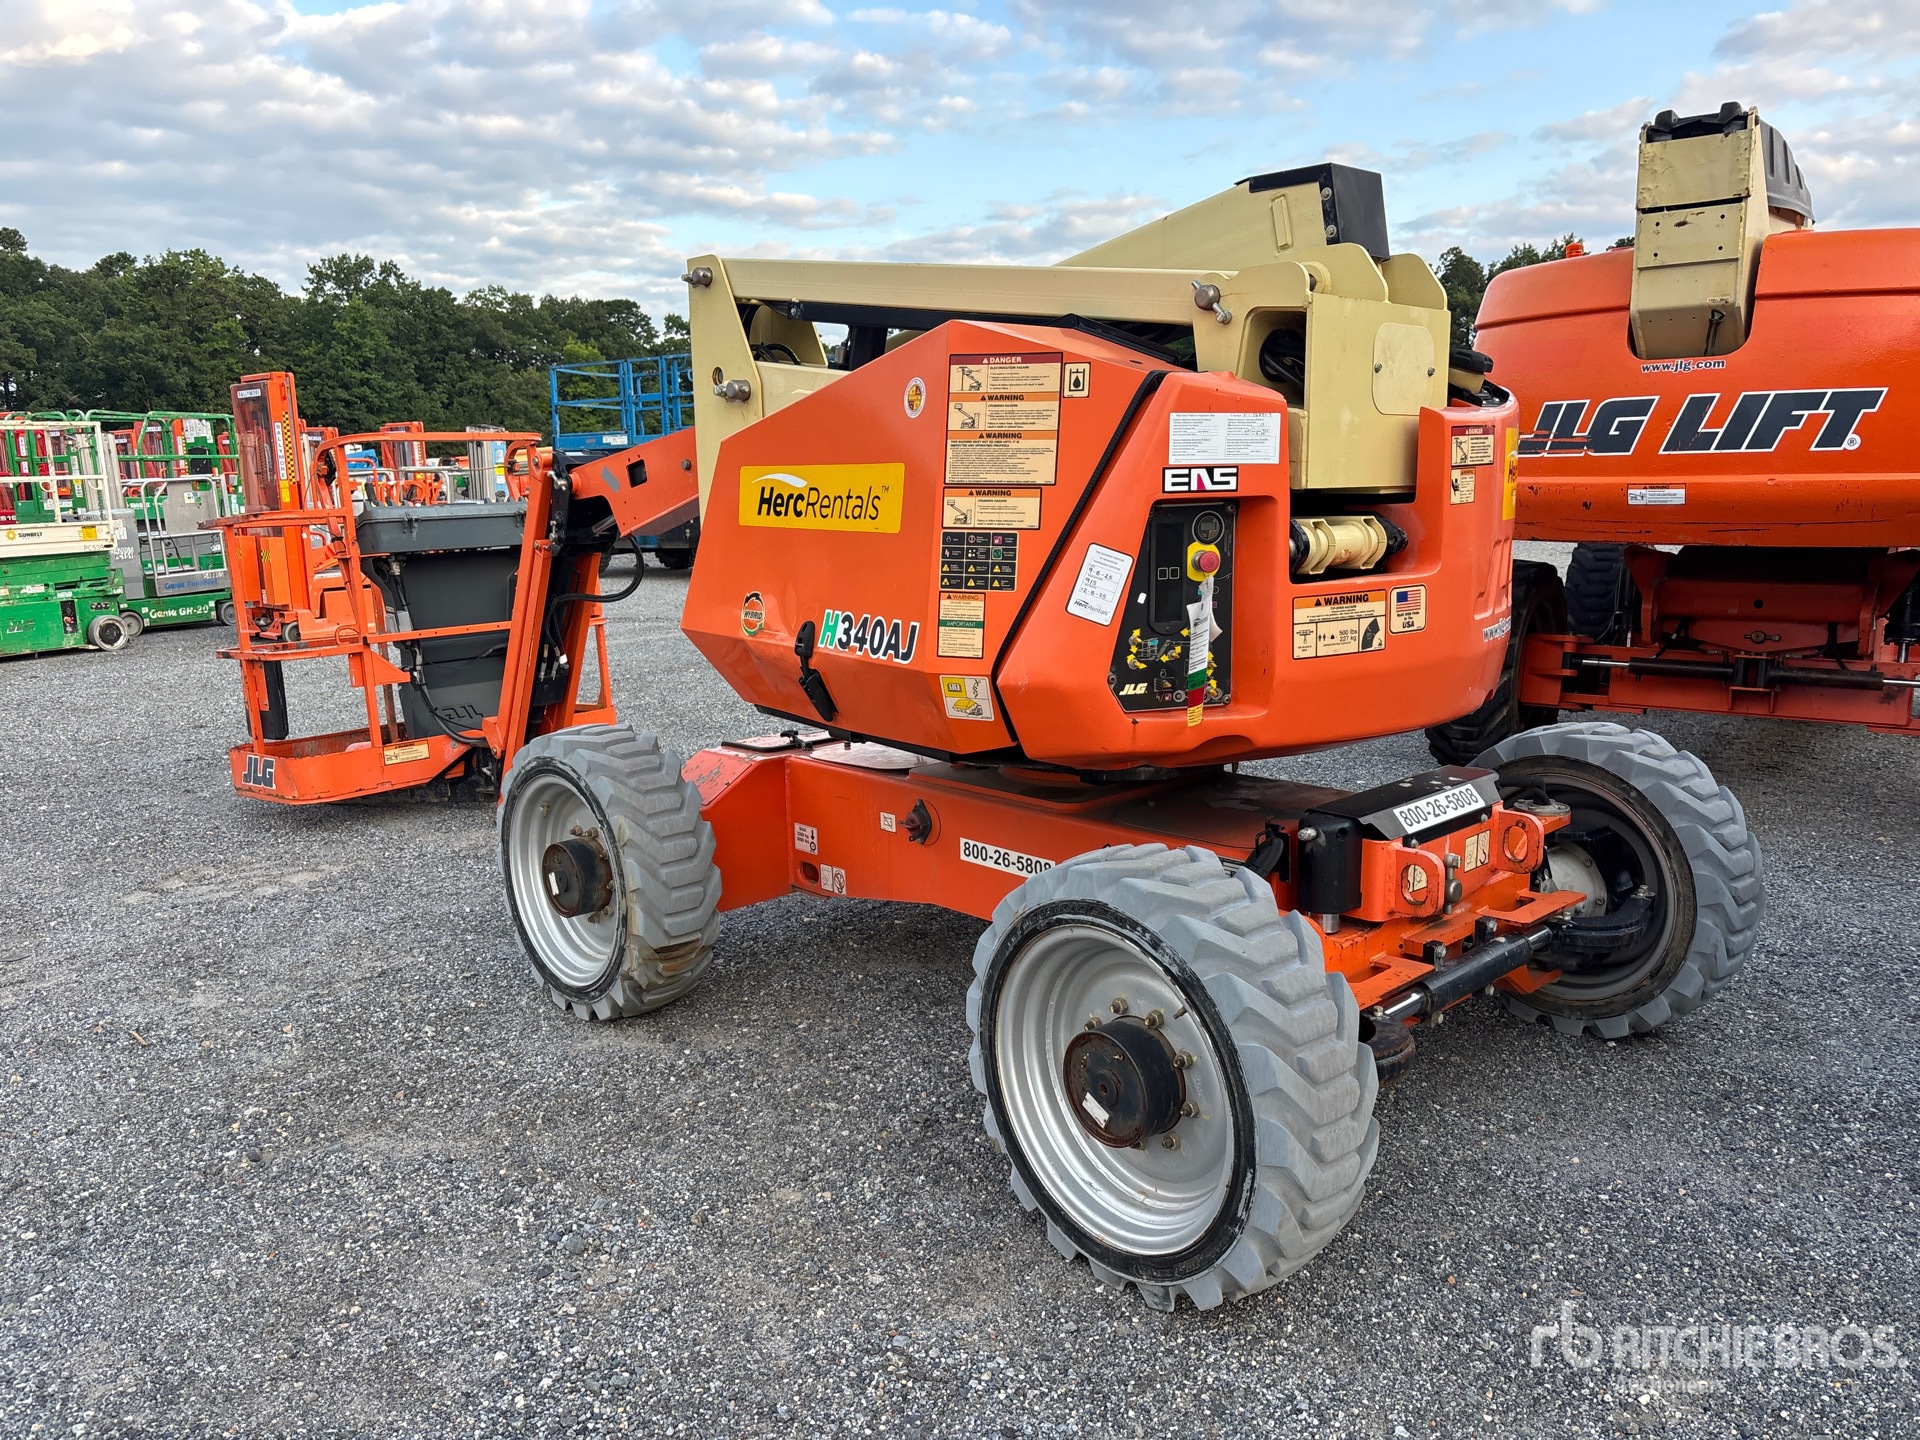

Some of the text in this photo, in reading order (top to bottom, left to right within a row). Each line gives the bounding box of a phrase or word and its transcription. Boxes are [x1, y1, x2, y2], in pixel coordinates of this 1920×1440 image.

[989, 356, 1022, 364] DANGER
[1641, 359, 1726, 374] www.jlg.com
[1518, 395, 1660, 458] JLG
[1657, 386, 1889, 455] LIFT
[275, 424, 286, 479] BALLYMORE
[757, 485, 881, 521] HercRentals
[1323, 593, 1369, 606] WARNING
[149, 608, 177, 619] Genie
[1402, 620, 1415, 629] USA
[818, 609, 919, 663] H340AJ
[1119, 682, 1148, 696] JLG
[242, 754, 277, 790] JLG
[1399, 787, 1479, 828] 800-26-5808
